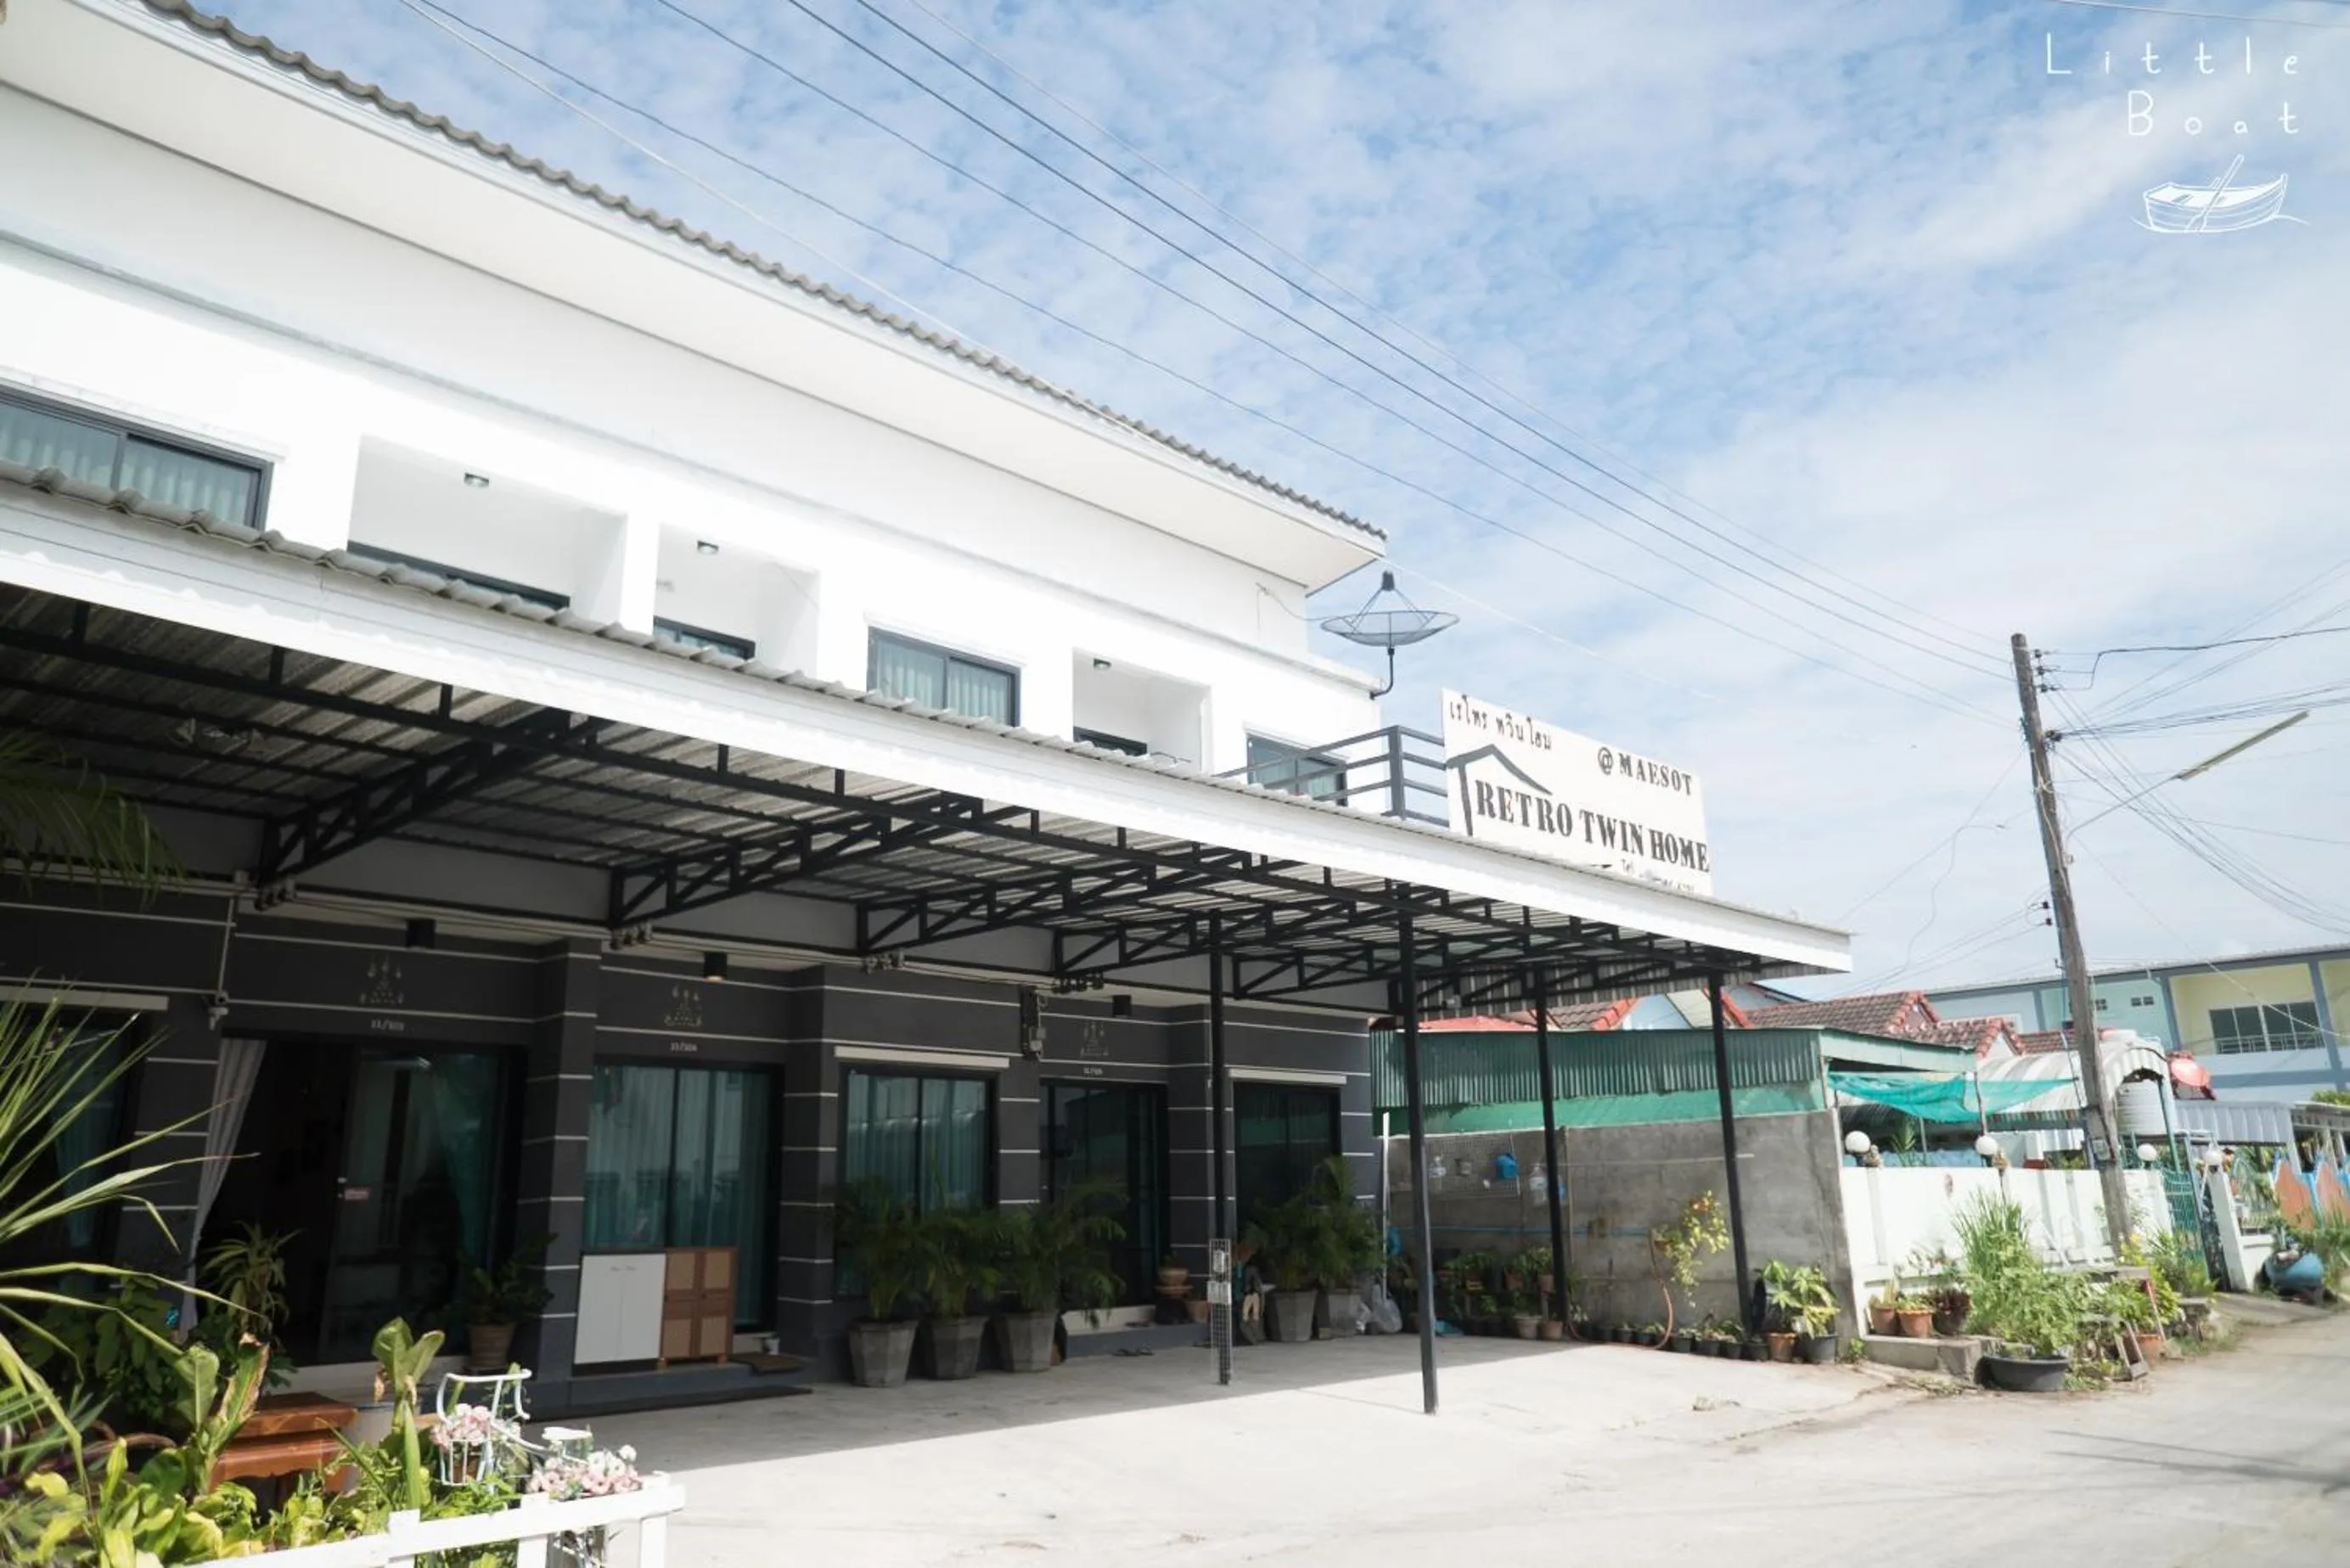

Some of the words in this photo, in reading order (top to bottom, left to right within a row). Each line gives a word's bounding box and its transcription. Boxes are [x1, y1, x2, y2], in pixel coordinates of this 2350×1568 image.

[1475, 779, 1572, 837] RETRO
[1578, 808, 1644, 857] TWIN
[1648, 827, 1711, 873] HOME
